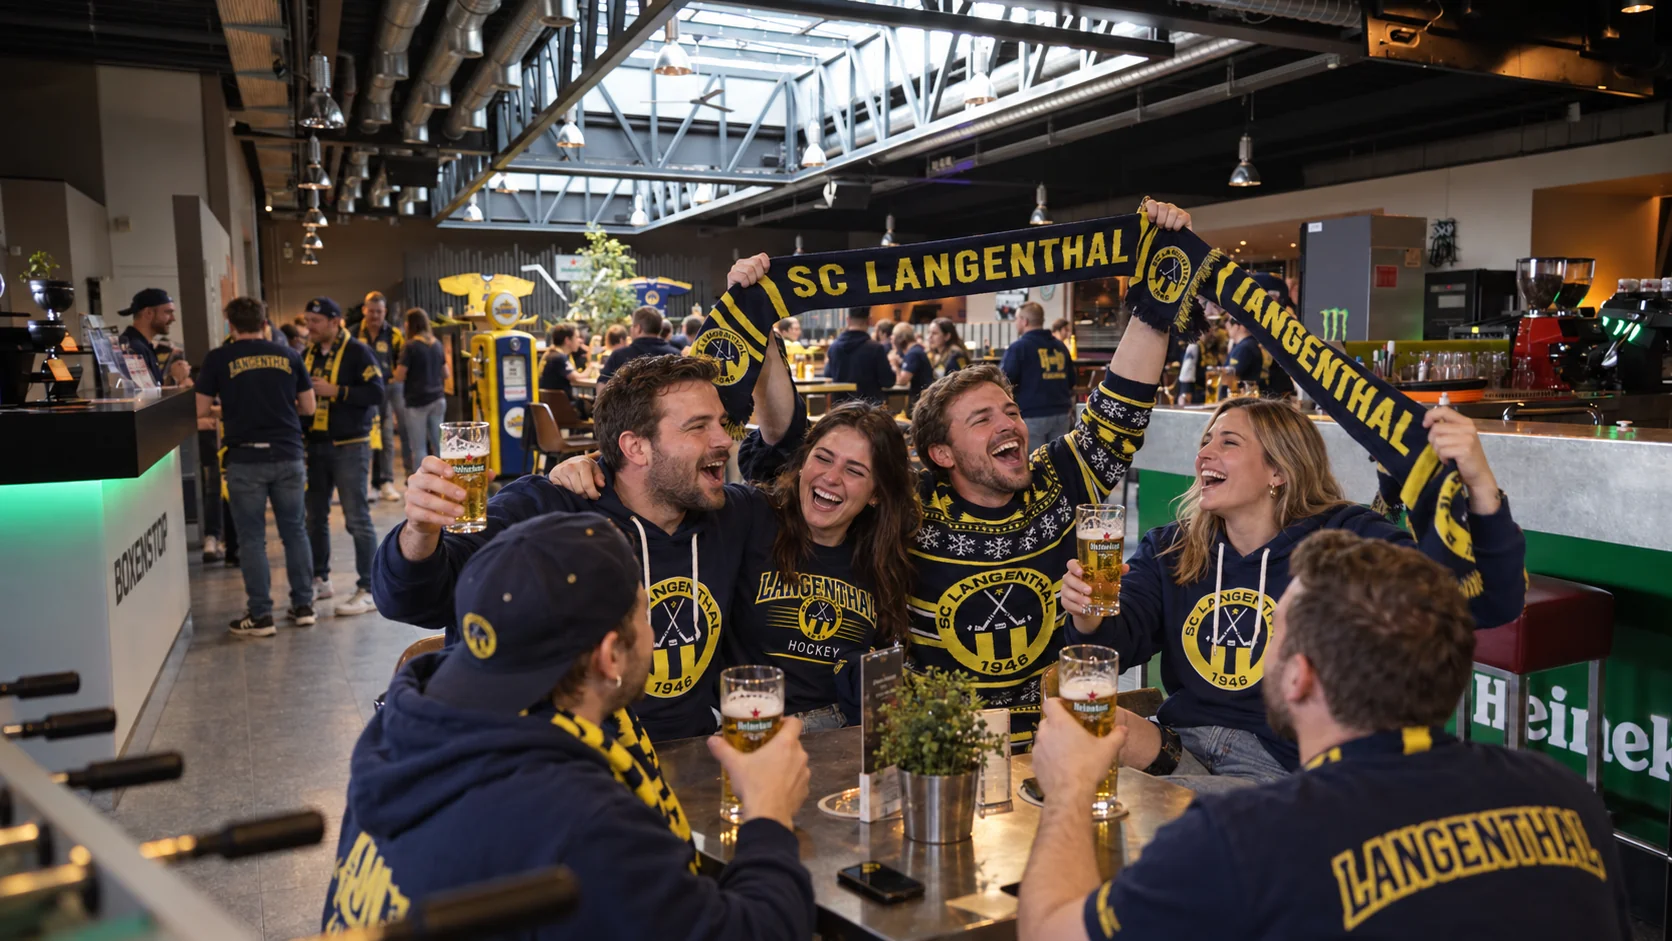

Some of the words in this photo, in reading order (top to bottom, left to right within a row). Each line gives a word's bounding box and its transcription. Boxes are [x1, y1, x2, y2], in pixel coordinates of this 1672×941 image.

[787, 263, 847, 298] SC
[865, 228, 1129, 294] LANGENTHAL
[114, 511, 168, 606] BOXENSTOP
[939, 605, 953, 629] SC
[947, 570, 1054, 614] LANGENTHAL
[1186, 616, 1200, 637] SC
[787, 639, 840, 659] HOCKEY
[980, 653, 1030, 673] 1946
[653, 675, 693, 695] 1946
[1211, 672, 1248, 688] 1946
[1330, 805, 1607, 932] LANGENTHAL
